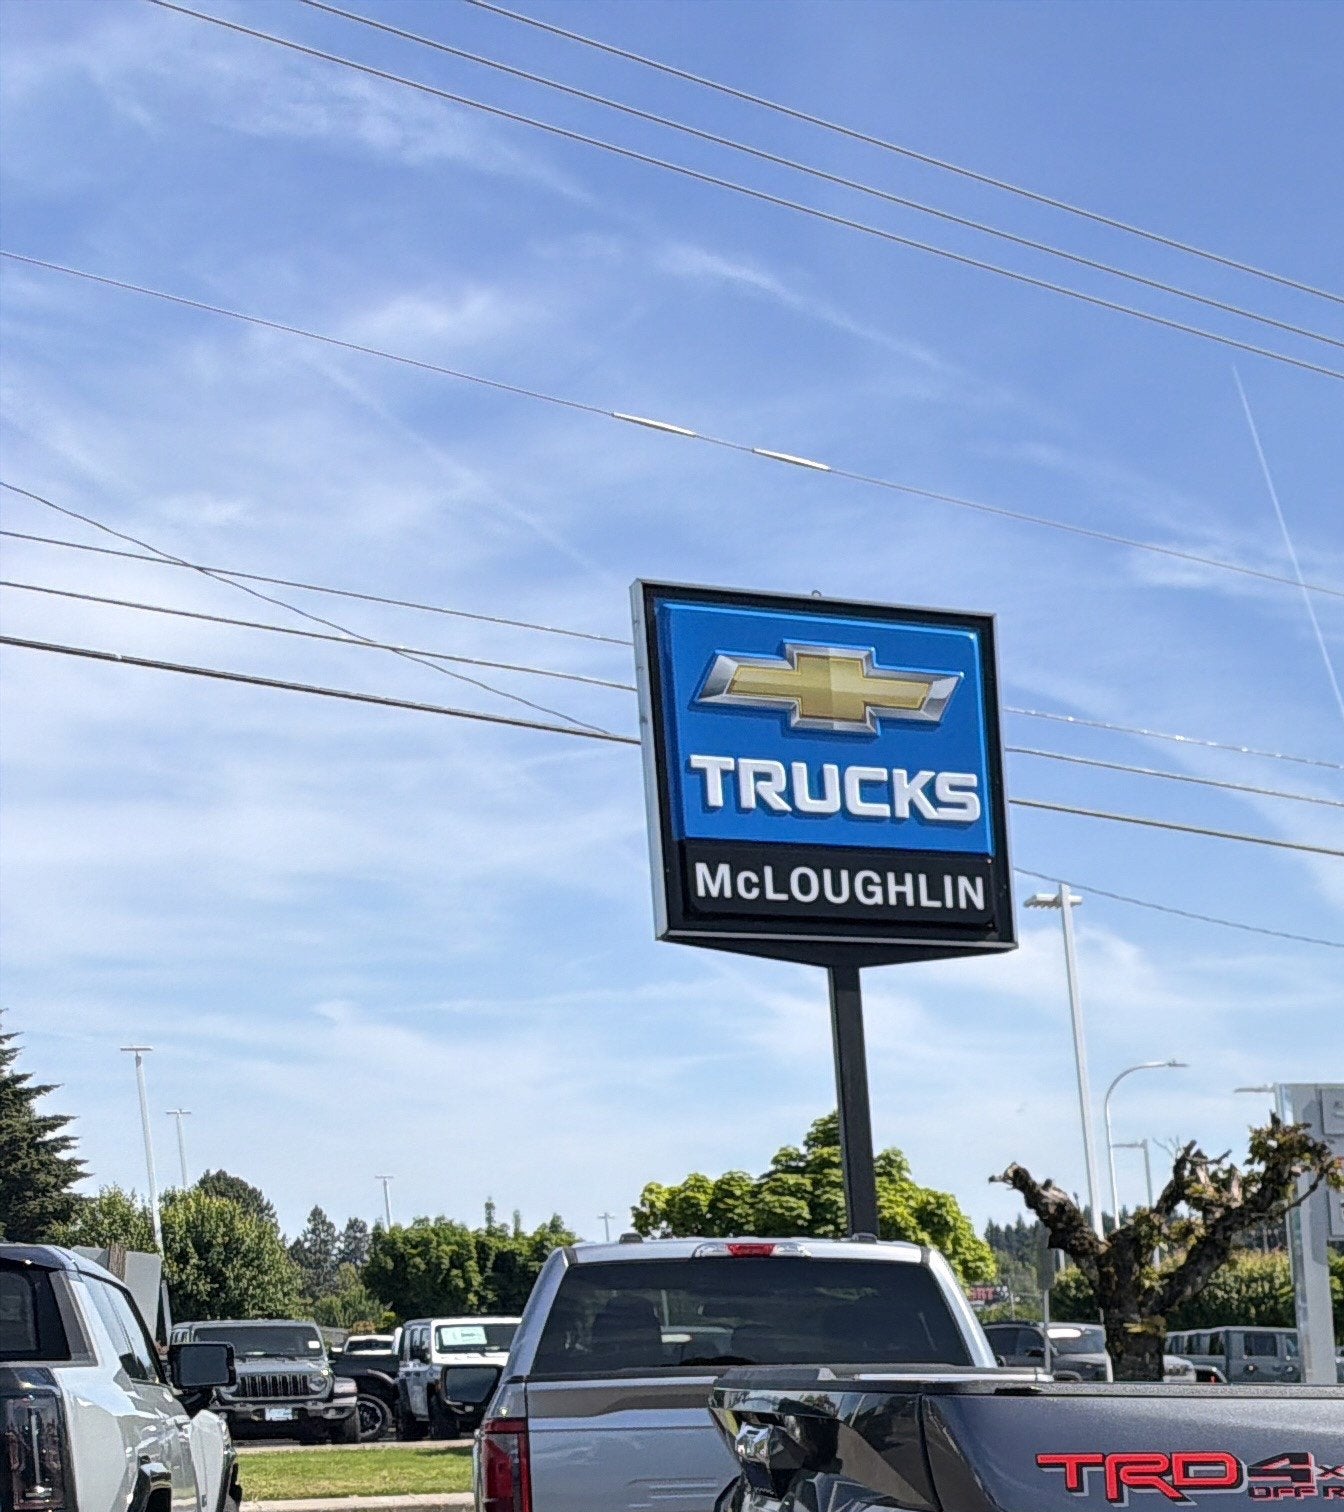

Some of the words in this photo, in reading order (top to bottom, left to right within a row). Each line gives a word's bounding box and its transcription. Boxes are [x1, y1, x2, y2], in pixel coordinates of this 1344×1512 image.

[690, 755, 981, 823] TRUCKS
[694, 861, 986, 911] McLOUGHLIN
[1035, 1451, 1247, 1506] TRD
[1248, 1484, 1318, 1501] OFF
